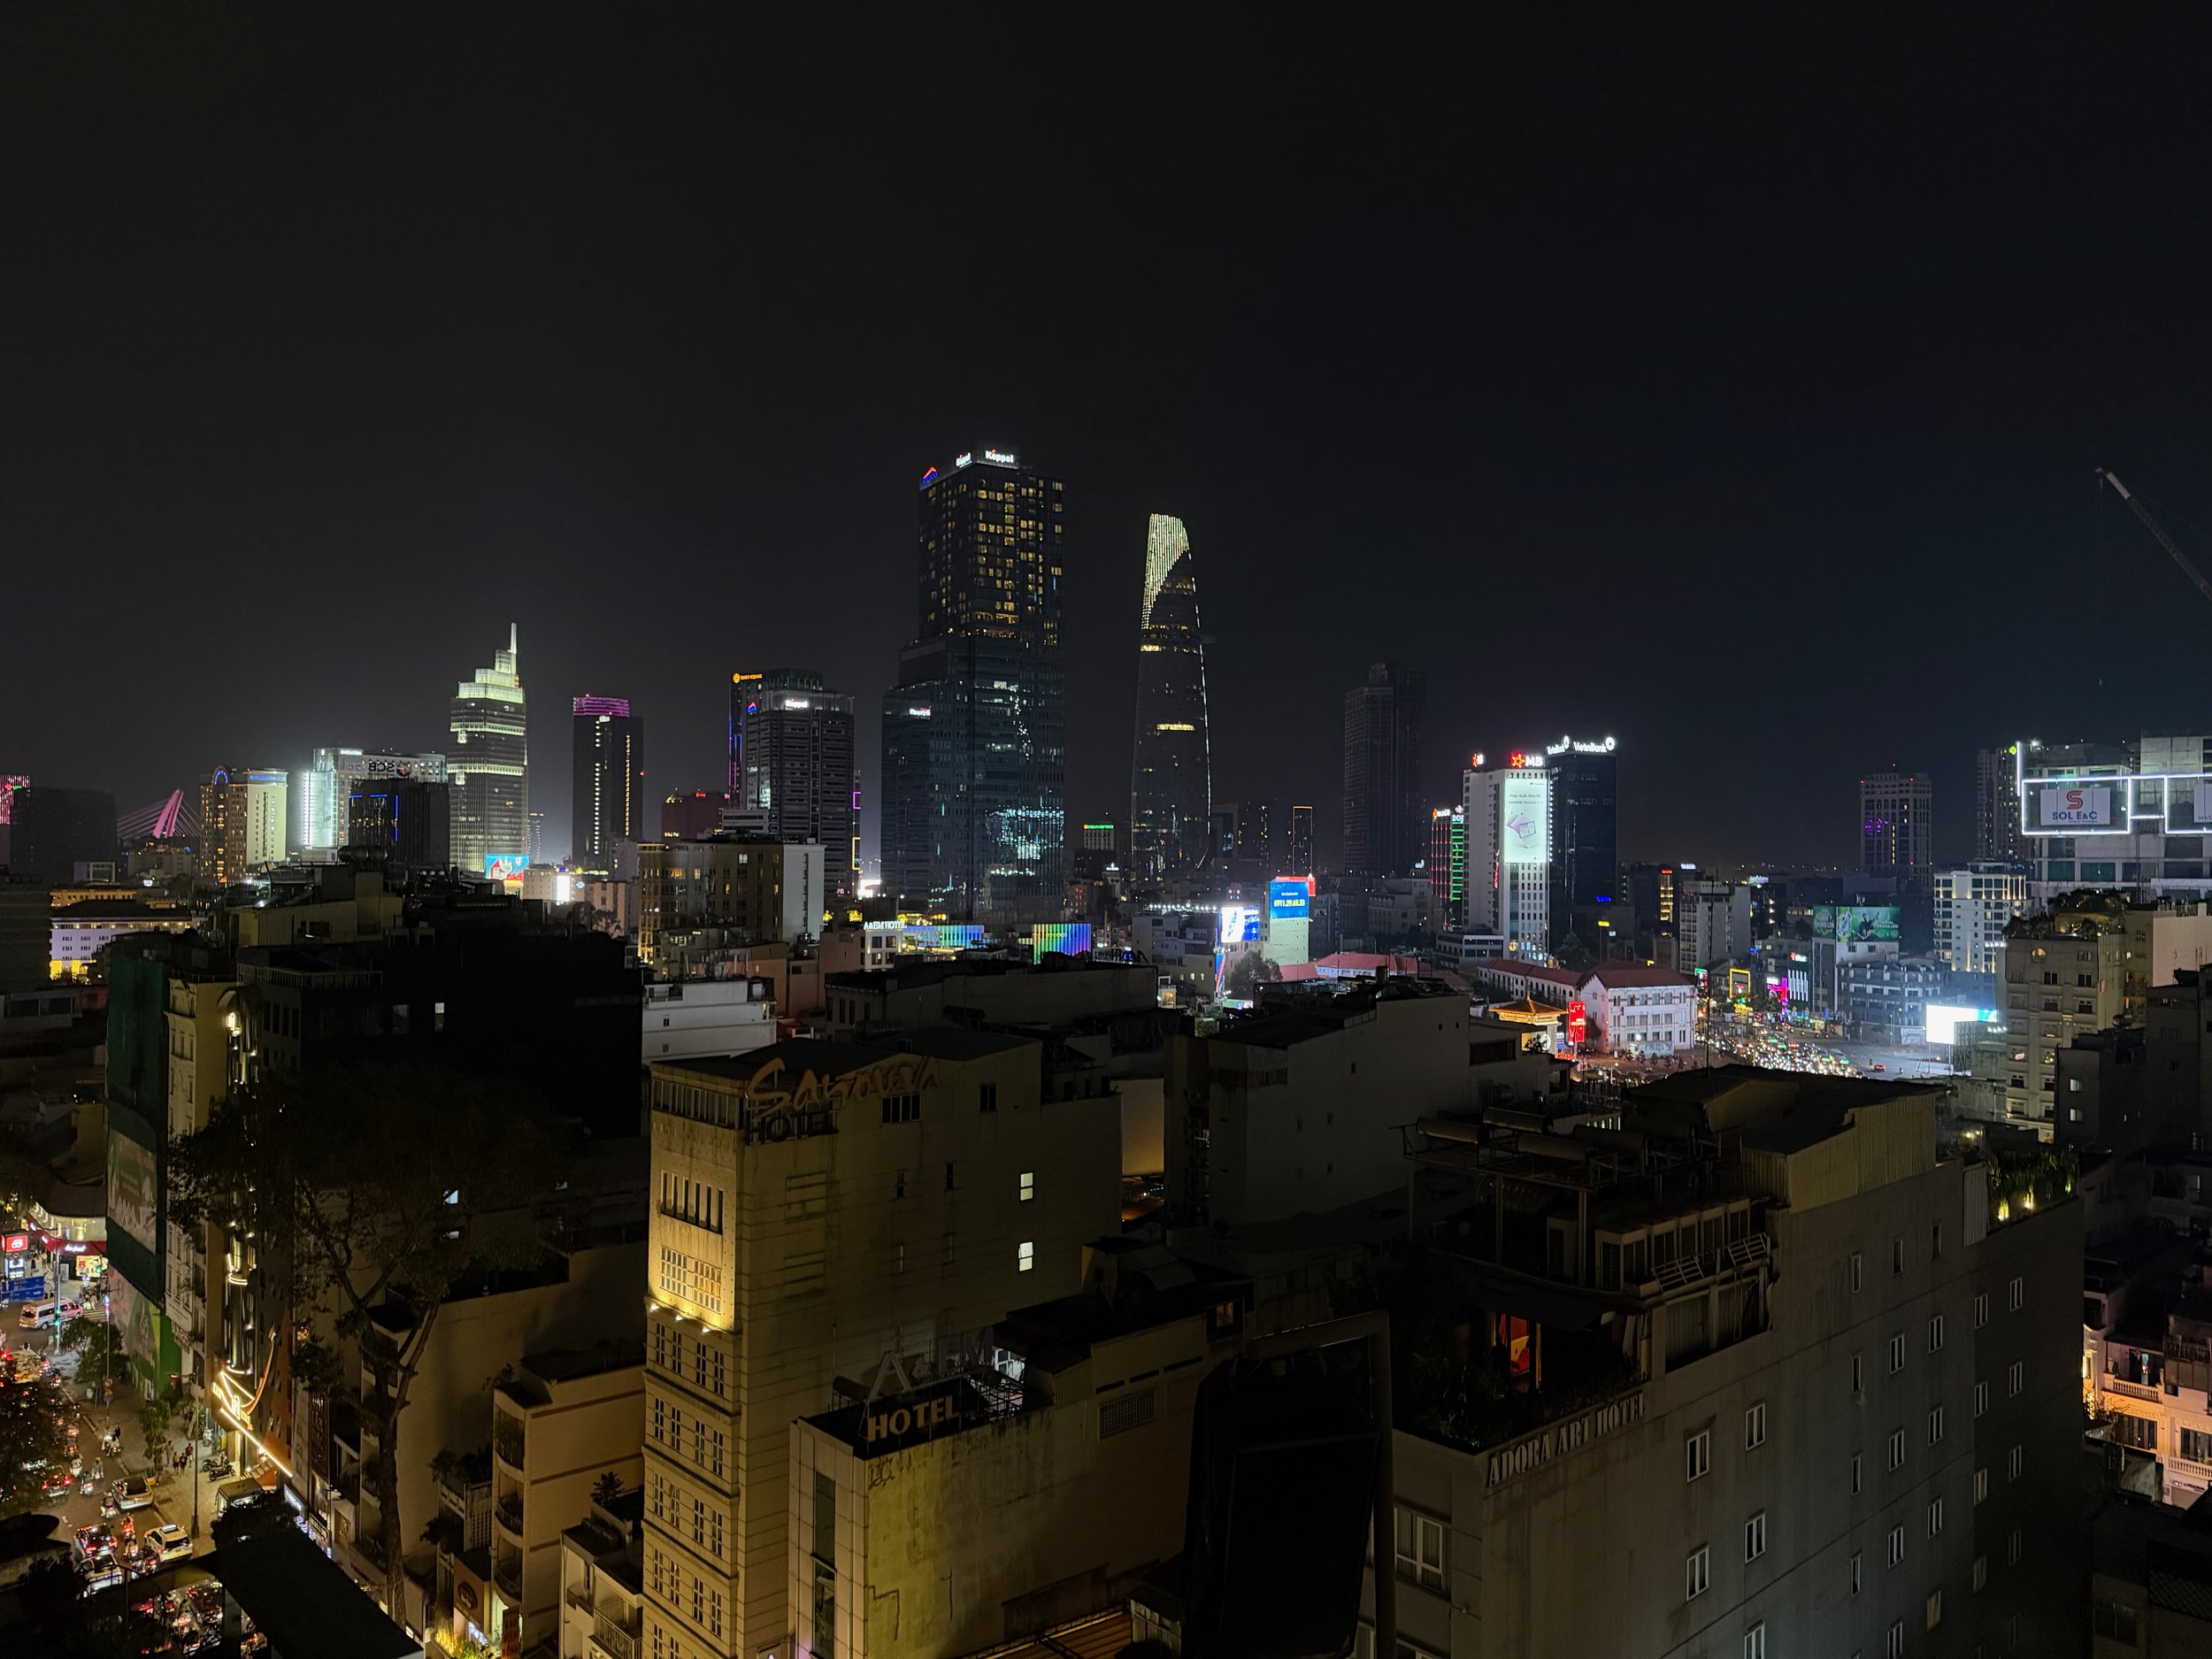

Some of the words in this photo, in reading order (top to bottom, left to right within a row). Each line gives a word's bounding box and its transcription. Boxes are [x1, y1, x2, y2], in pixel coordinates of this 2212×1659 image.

[985, 450, 1014, 464] Keppel
[1525, 756, 1544, 767] MB
[2052, 811, 2073, 820] SOL
[2077, 811, 2098, 820] E&C
[885, 920, 907, 929] HOTEL
[745, 1110, 838, 1146] HOTEL
[867, 1394, 960, 1443] HOTEL
[1487, 1433, 1551, 1487] ADORA
[1556, 1416, 1591, 1455] ART
[1595, 1393, 1646, 1438] HOTEL
